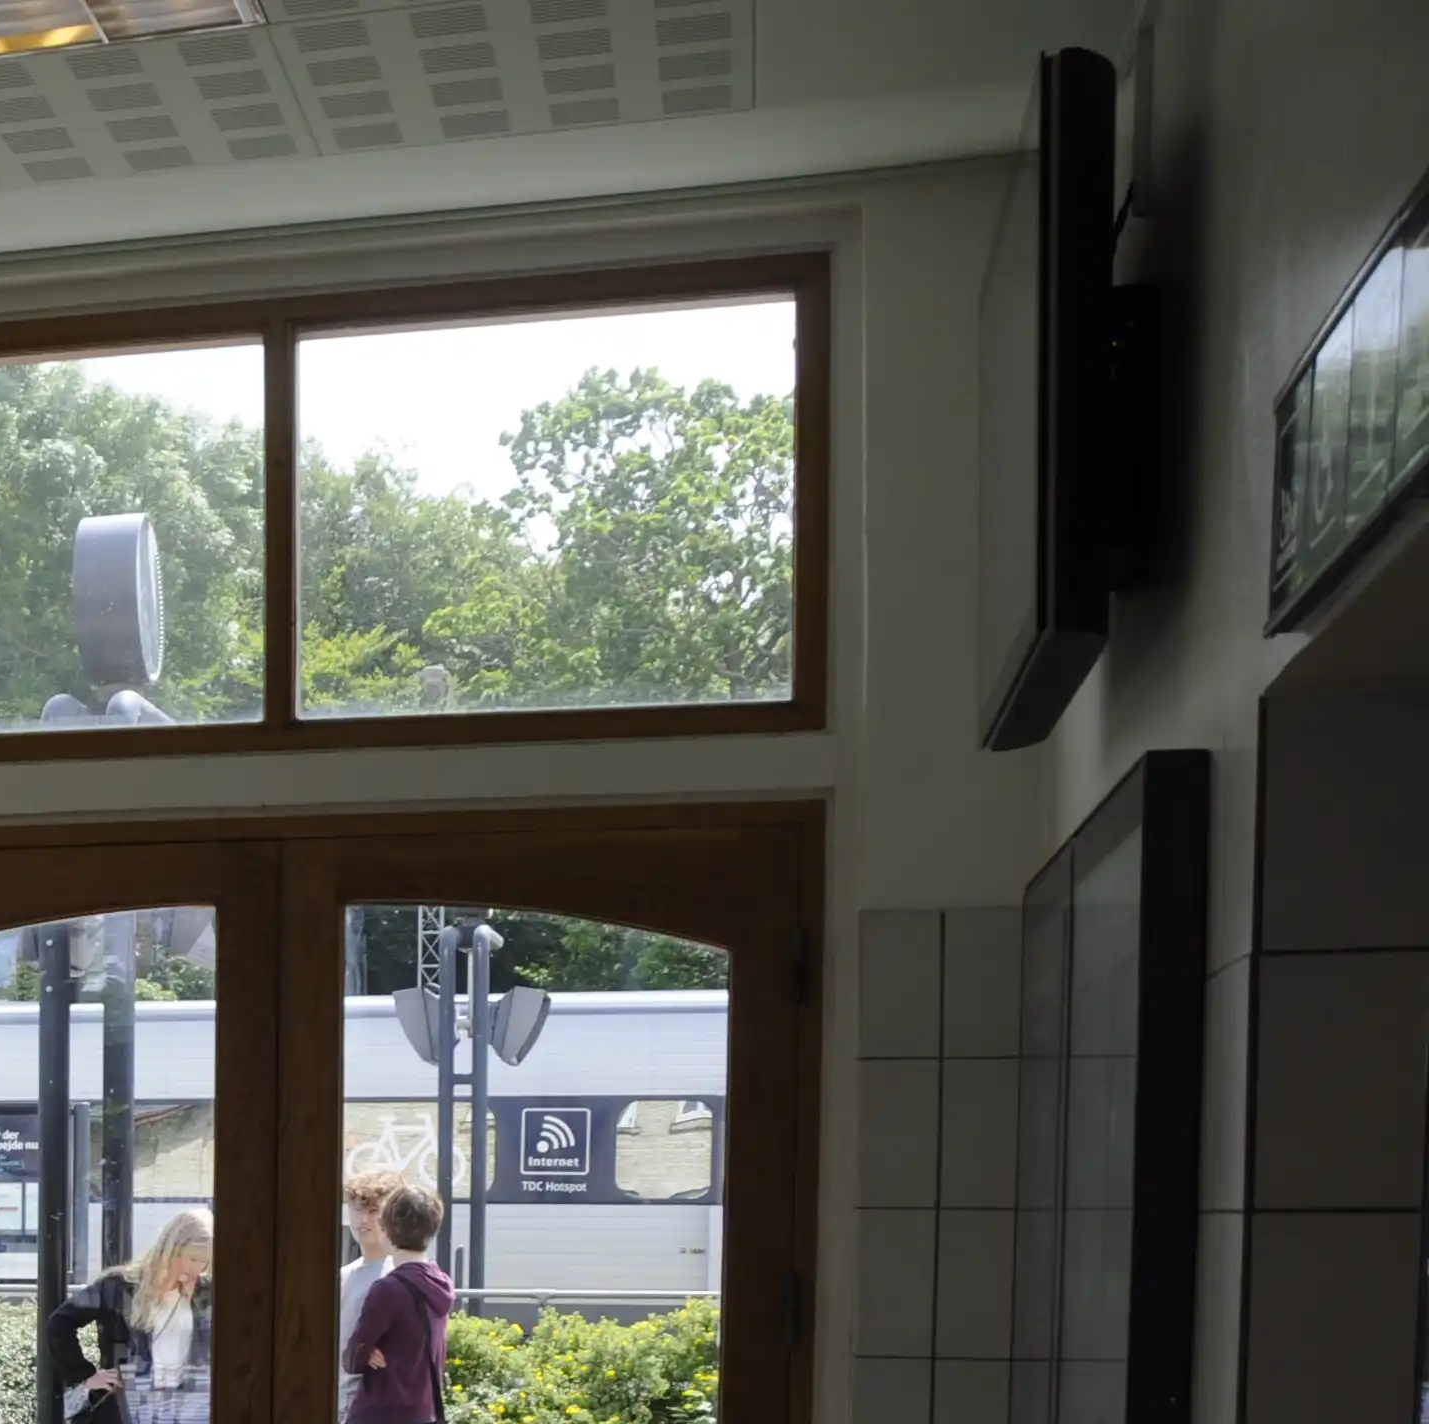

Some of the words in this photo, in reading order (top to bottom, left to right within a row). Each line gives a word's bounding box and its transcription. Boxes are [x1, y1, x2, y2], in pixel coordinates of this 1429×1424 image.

[528, 1156, 580, 1168] Internet
[521, 1180, 544, 1192] TDC
[545, 1180, 588, 1193] Hotspot
